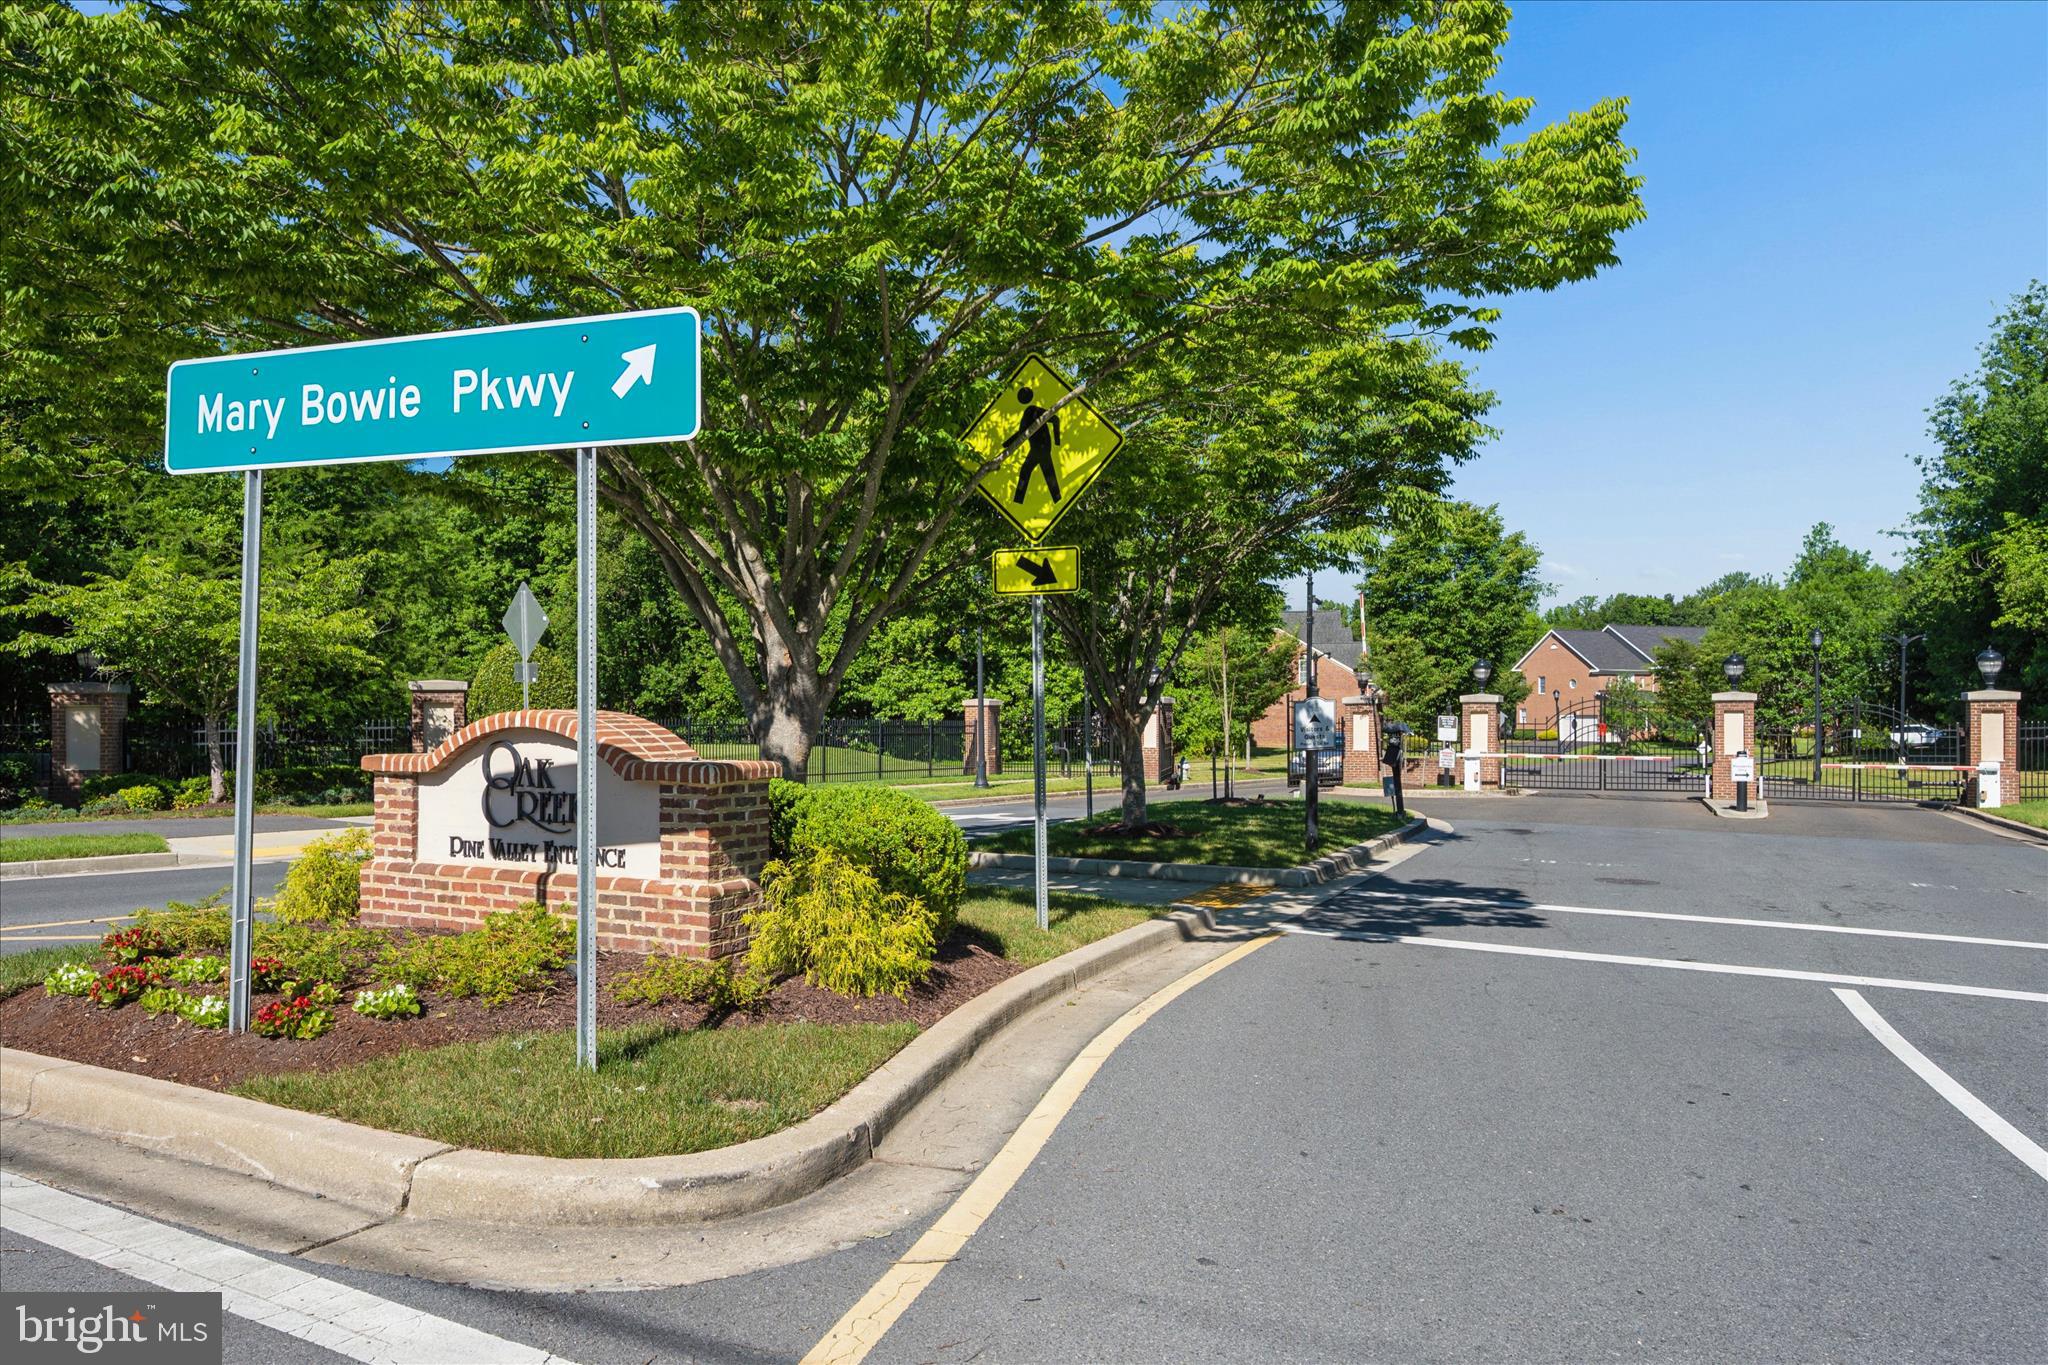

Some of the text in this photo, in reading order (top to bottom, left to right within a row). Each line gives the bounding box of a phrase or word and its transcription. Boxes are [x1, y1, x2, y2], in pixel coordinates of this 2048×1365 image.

[197, 367, 575, 439] Mary Bowie Pkwy
[450, 836, 484, 859] PINE
[488, 837, 538, 863] VALLEY
